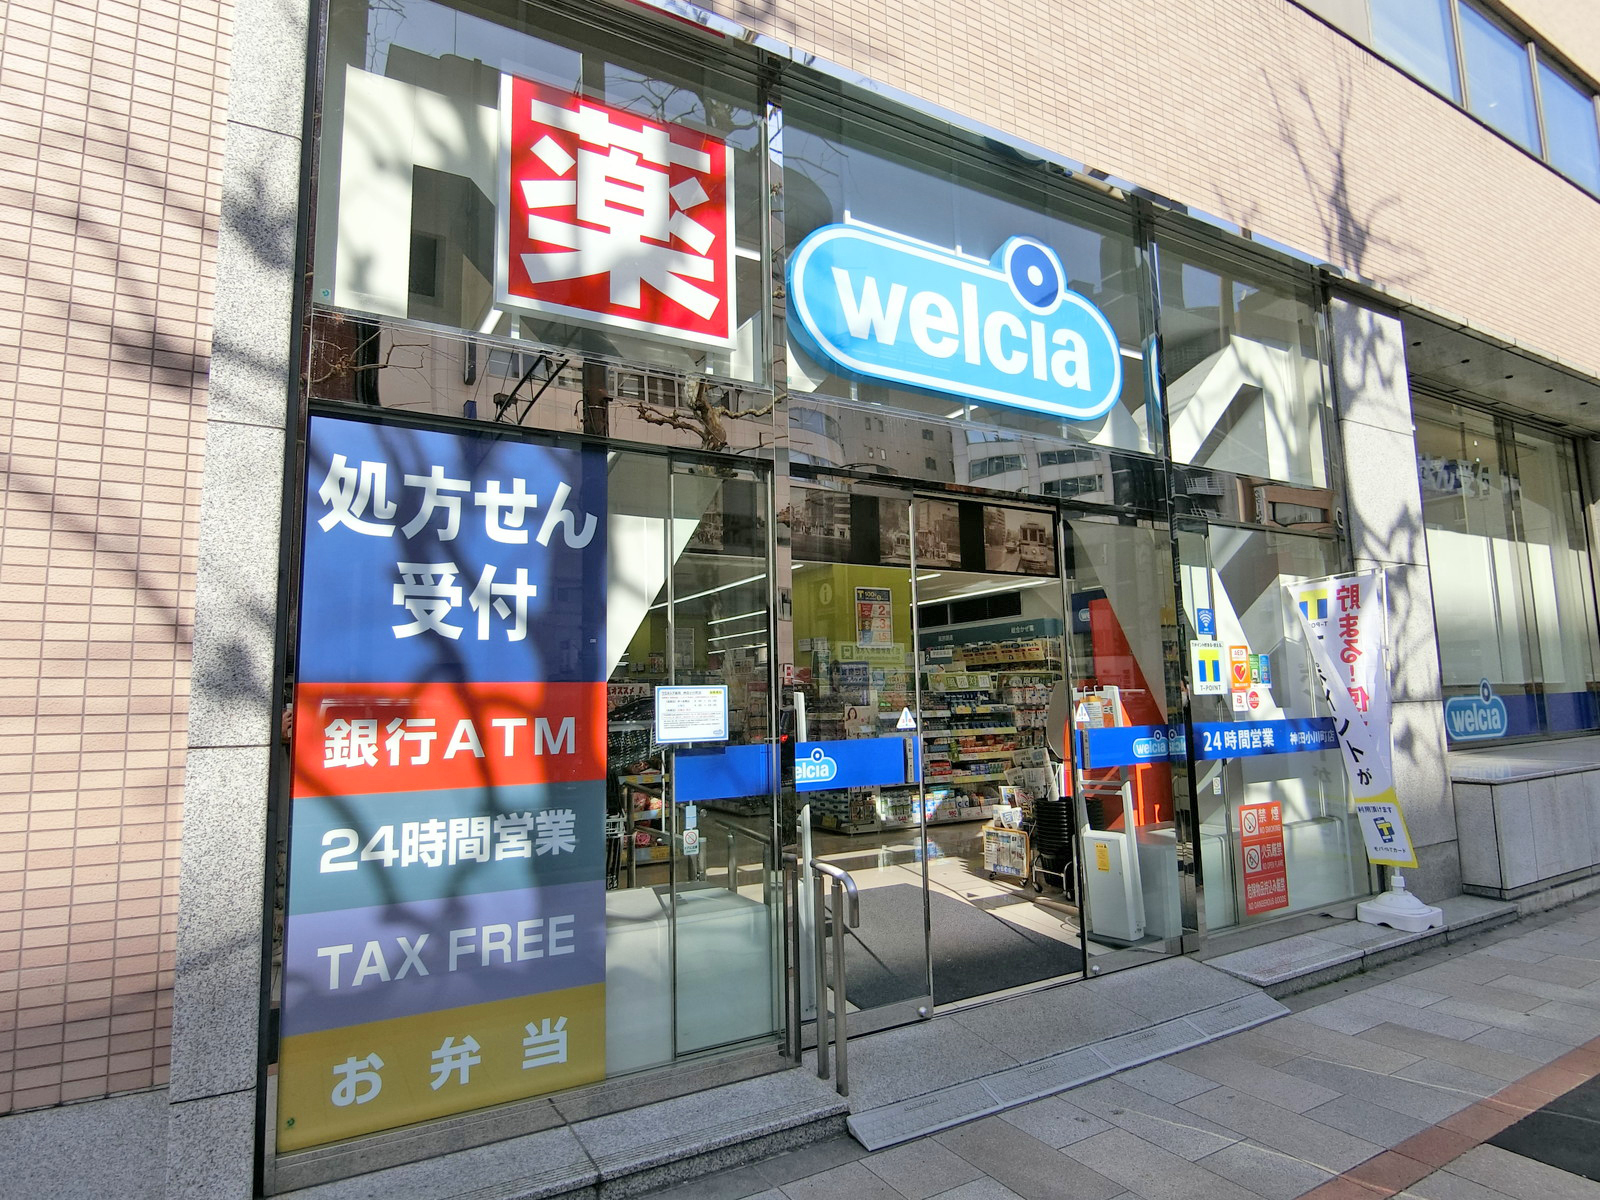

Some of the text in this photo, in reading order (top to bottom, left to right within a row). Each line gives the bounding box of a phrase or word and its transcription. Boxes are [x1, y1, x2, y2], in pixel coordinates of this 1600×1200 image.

[520, 99, 720, 320] 薬
[831, 265, 1091, 392] welcia
[318, 453, 598, 548] 処方せん
[392, 562, 537, 642] 受付
[323, 716, 576, 768] 銀行ATM
[1135, 740, 1166, 755] welcia
[1203, 727, 1335, 751] 24時間営業 神田小川町店
[1451, 703, 1501, 733] welcia
[320, 809, 576, 873] 24時間営業
[1258, 806, 1279, 823] 禁煙
[318, 916, 576, 990] TAX FREE
[331, 1017, 568, 1107] お弁当
